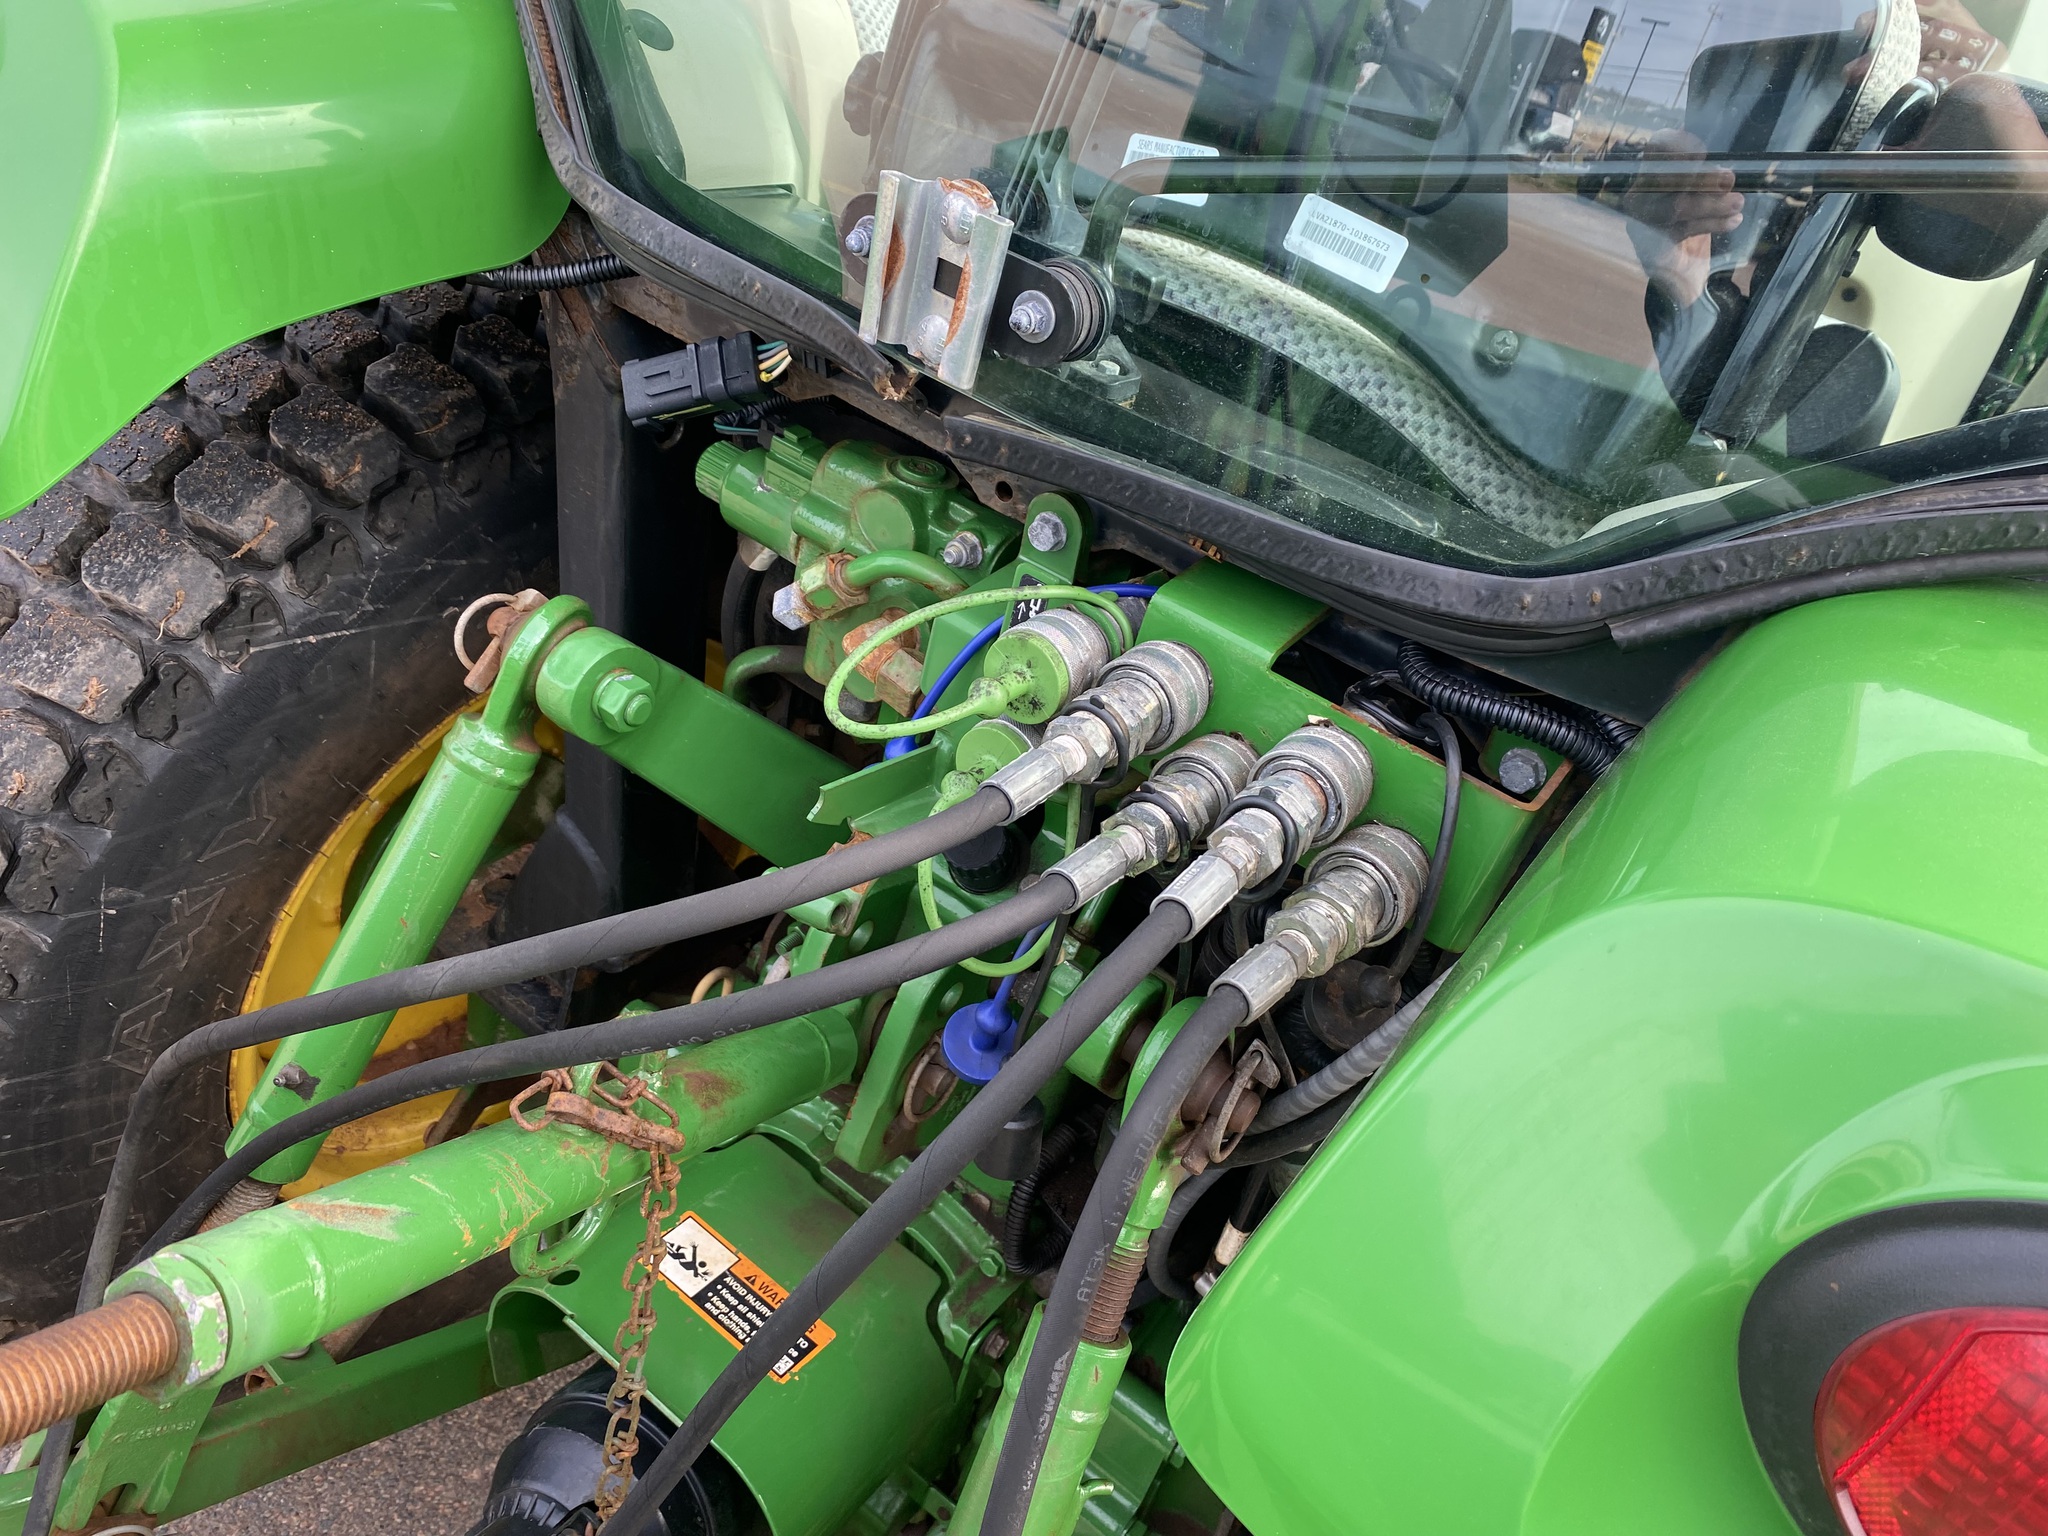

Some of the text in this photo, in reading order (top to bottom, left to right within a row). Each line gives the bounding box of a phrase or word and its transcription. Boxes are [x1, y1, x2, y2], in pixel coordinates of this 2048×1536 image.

[1137, 139, 1153, 152] SEARS
[711, 1296, 729, 1314] Keep
[723, 1276, 747, 1296] AVOID
[744, 1293, 774, 1318] INJURY
[704, 1302, 720, 1316] and
[719, 1288, 765, 1328] Keep all shiel
